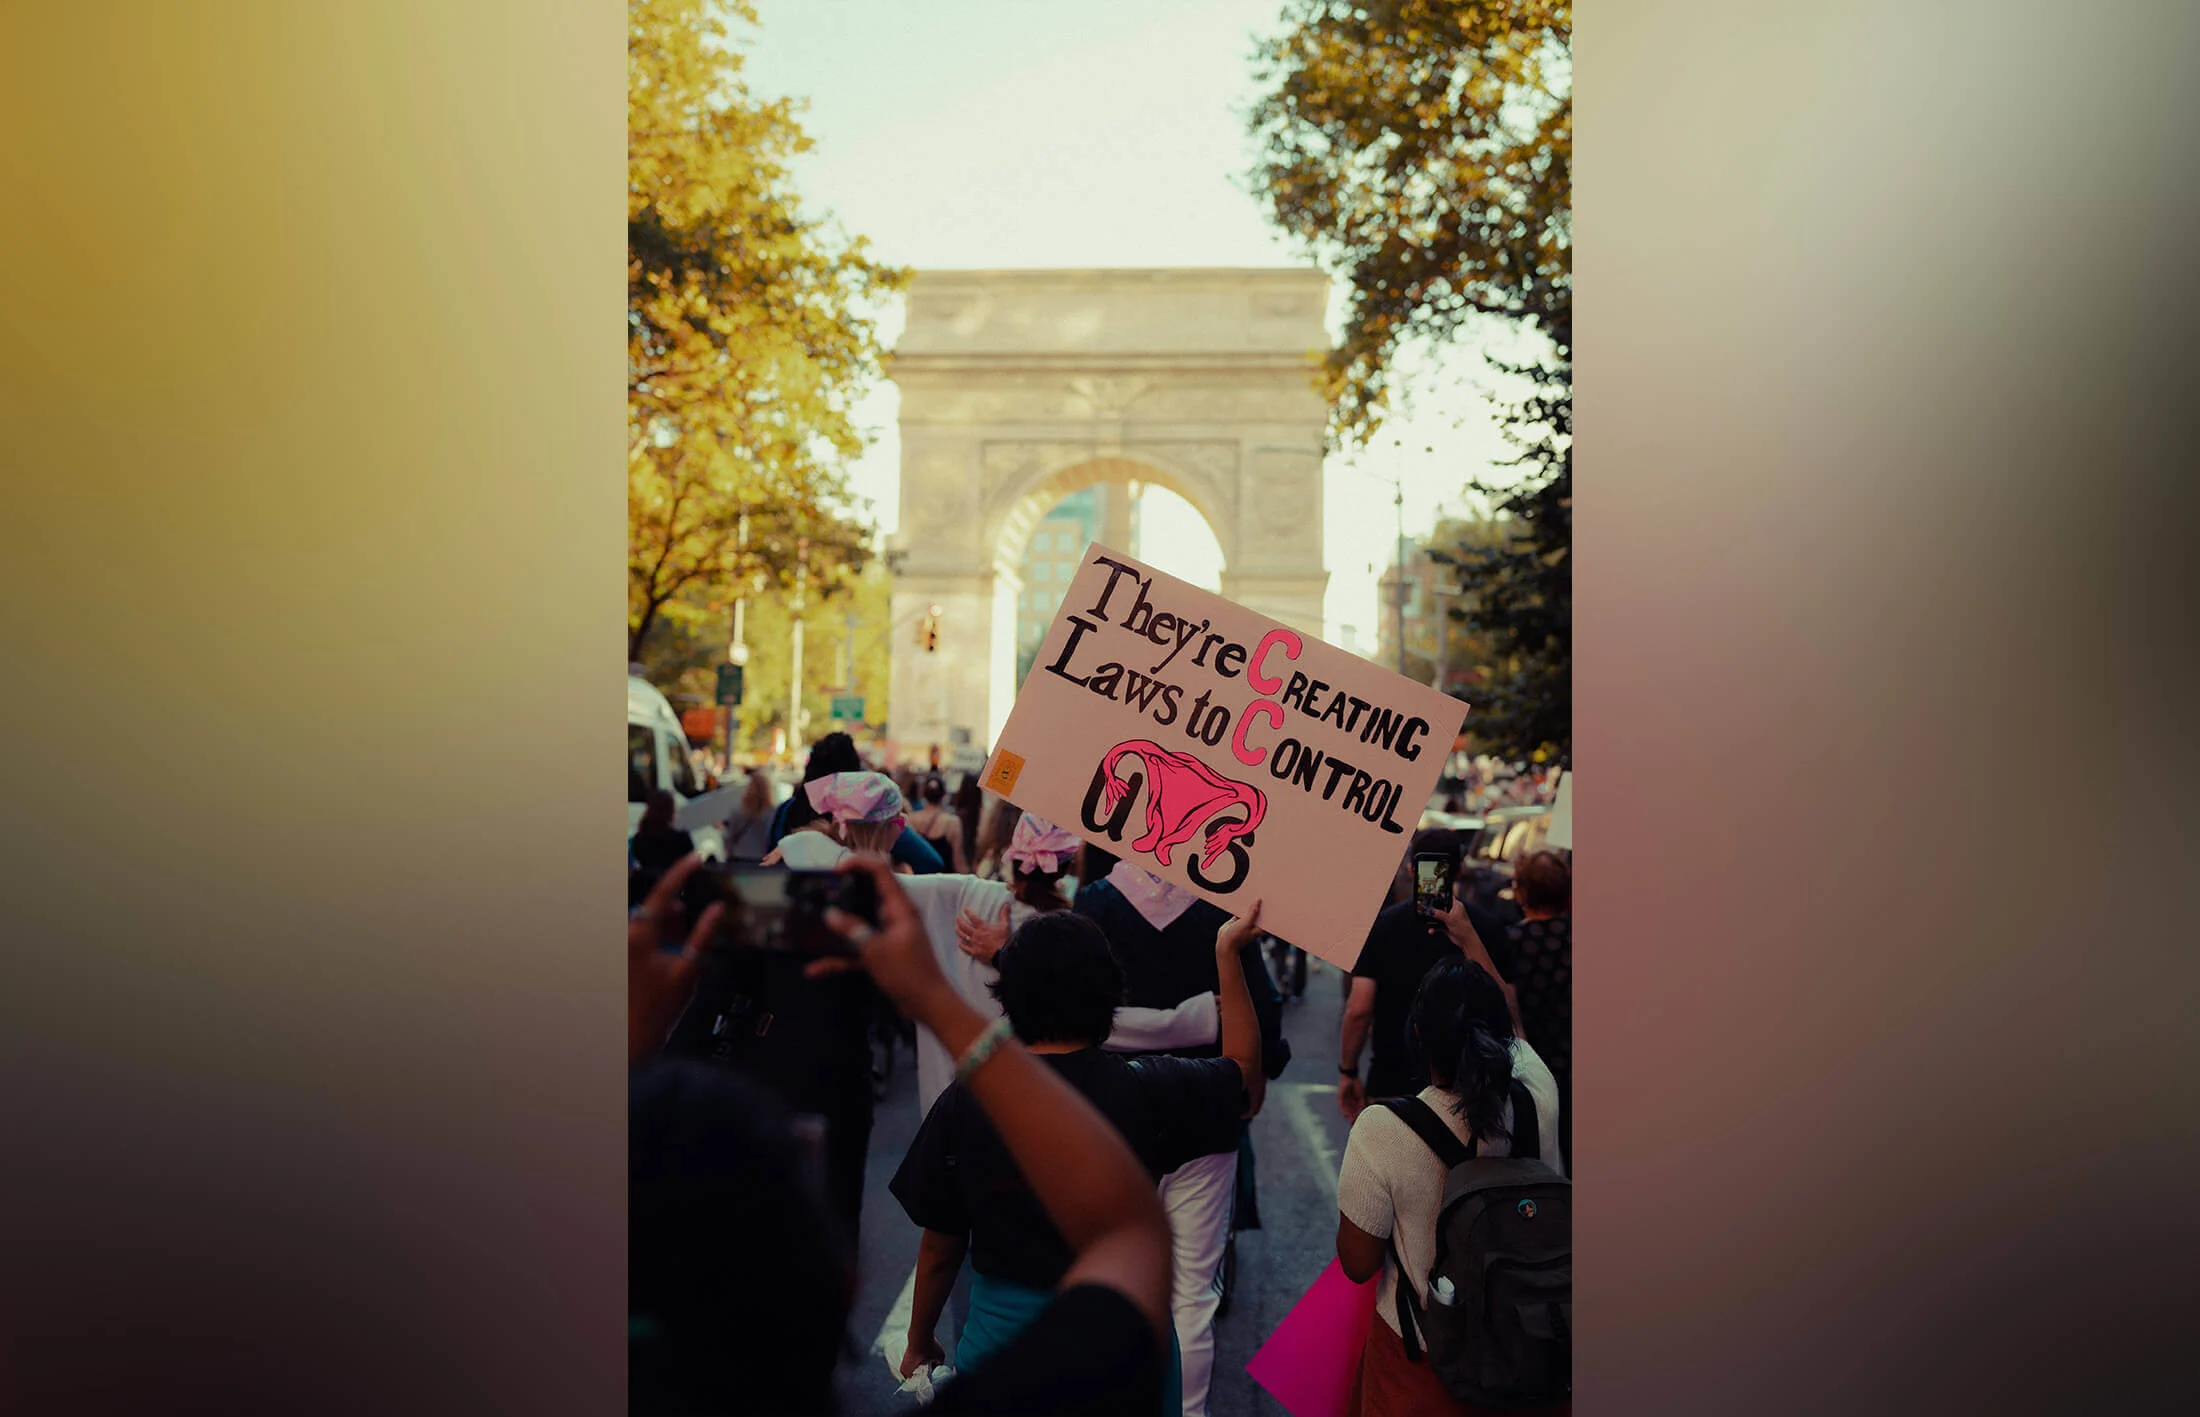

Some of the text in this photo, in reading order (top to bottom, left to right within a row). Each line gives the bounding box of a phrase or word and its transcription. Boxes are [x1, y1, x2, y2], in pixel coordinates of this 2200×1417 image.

[1044, 615, 1404, 834] Laws to CONTROL
[1087, 556, 1430, 762] They're CREATING
